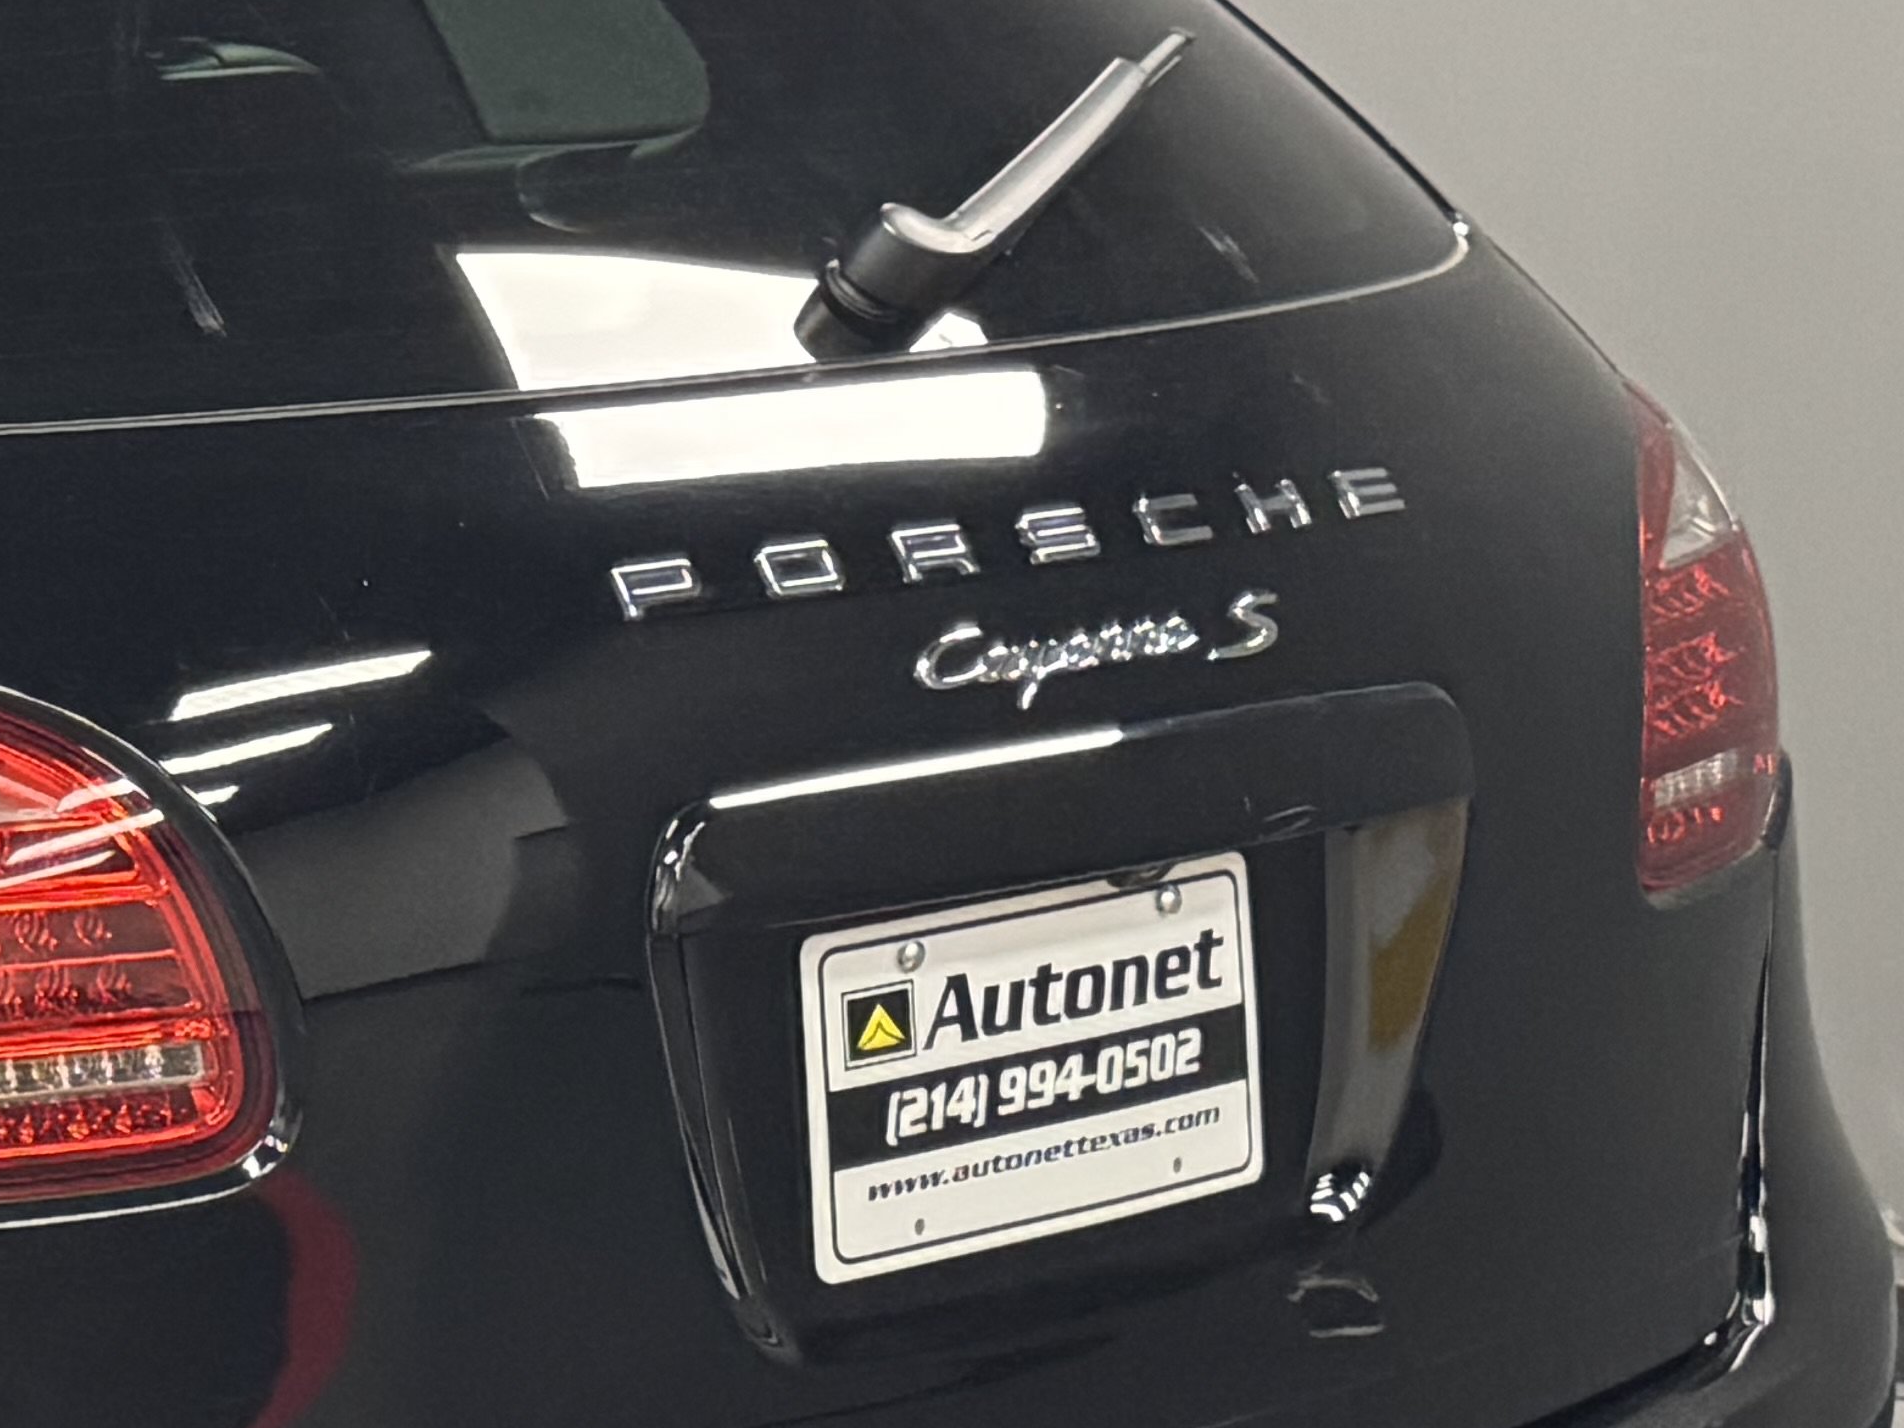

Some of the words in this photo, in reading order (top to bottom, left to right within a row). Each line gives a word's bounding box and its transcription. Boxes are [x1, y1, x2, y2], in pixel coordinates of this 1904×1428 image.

[611, 467, 1405, 621] PORSCHE
[913, 614, 1200, 711] Cayenne
[1205, 588, 1280, 662] S
[924, 928, 1224, 1050] Autonet
[886, 1069, 989, 1146] (214)
[997, 1027, 1202, 1117] 994-0502
[867, 1105, 1221, 1202] www.autonettexas.com
